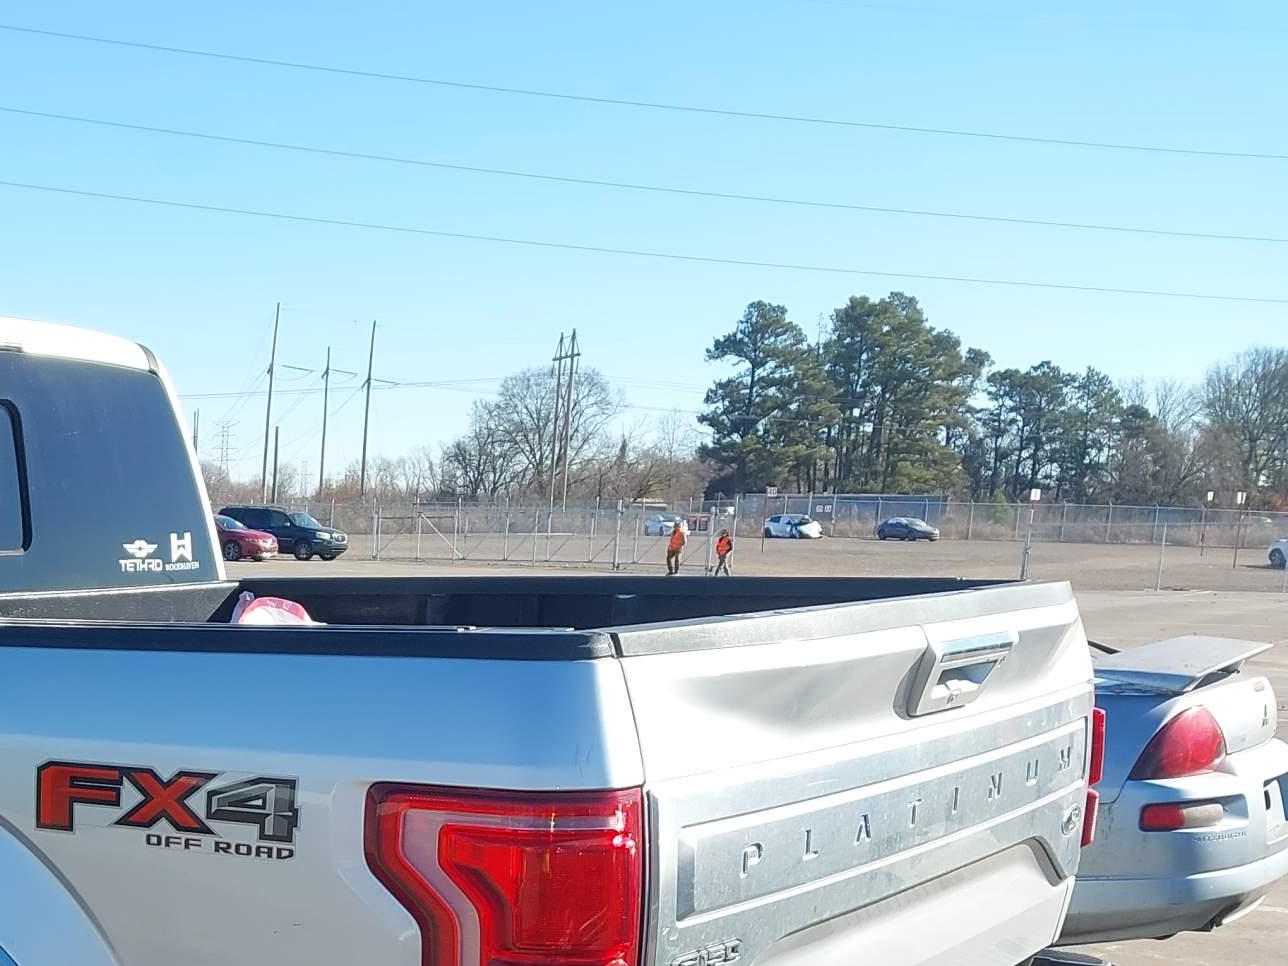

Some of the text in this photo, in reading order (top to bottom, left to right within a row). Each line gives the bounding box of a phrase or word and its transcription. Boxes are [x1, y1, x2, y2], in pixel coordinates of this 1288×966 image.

[36, 761, 298, 843] FX4
[740, 745, 1072, 878] PLATINUM
[146, 834, 294, 860] OFF ROAD
